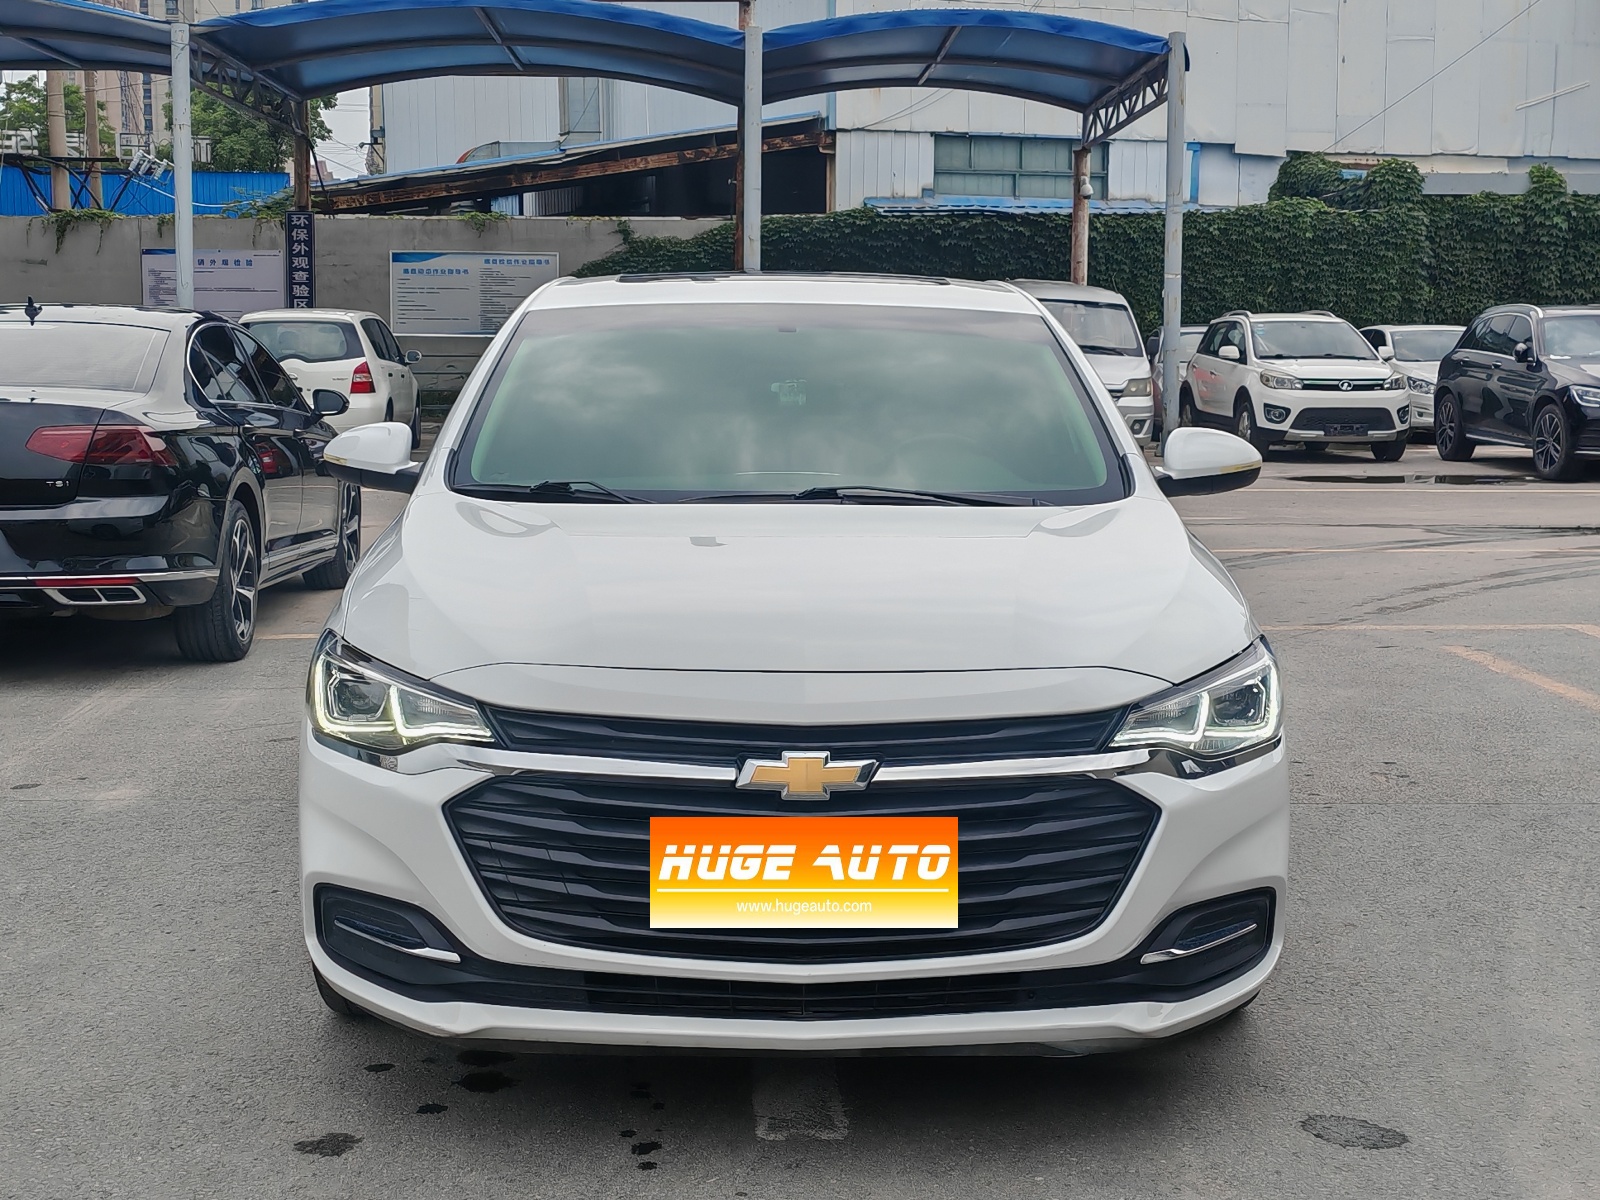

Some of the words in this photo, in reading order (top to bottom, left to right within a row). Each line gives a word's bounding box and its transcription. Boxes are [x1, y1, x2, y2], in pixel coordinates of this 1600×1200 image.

[291, 214, 310, 308] 环保外观查验区
